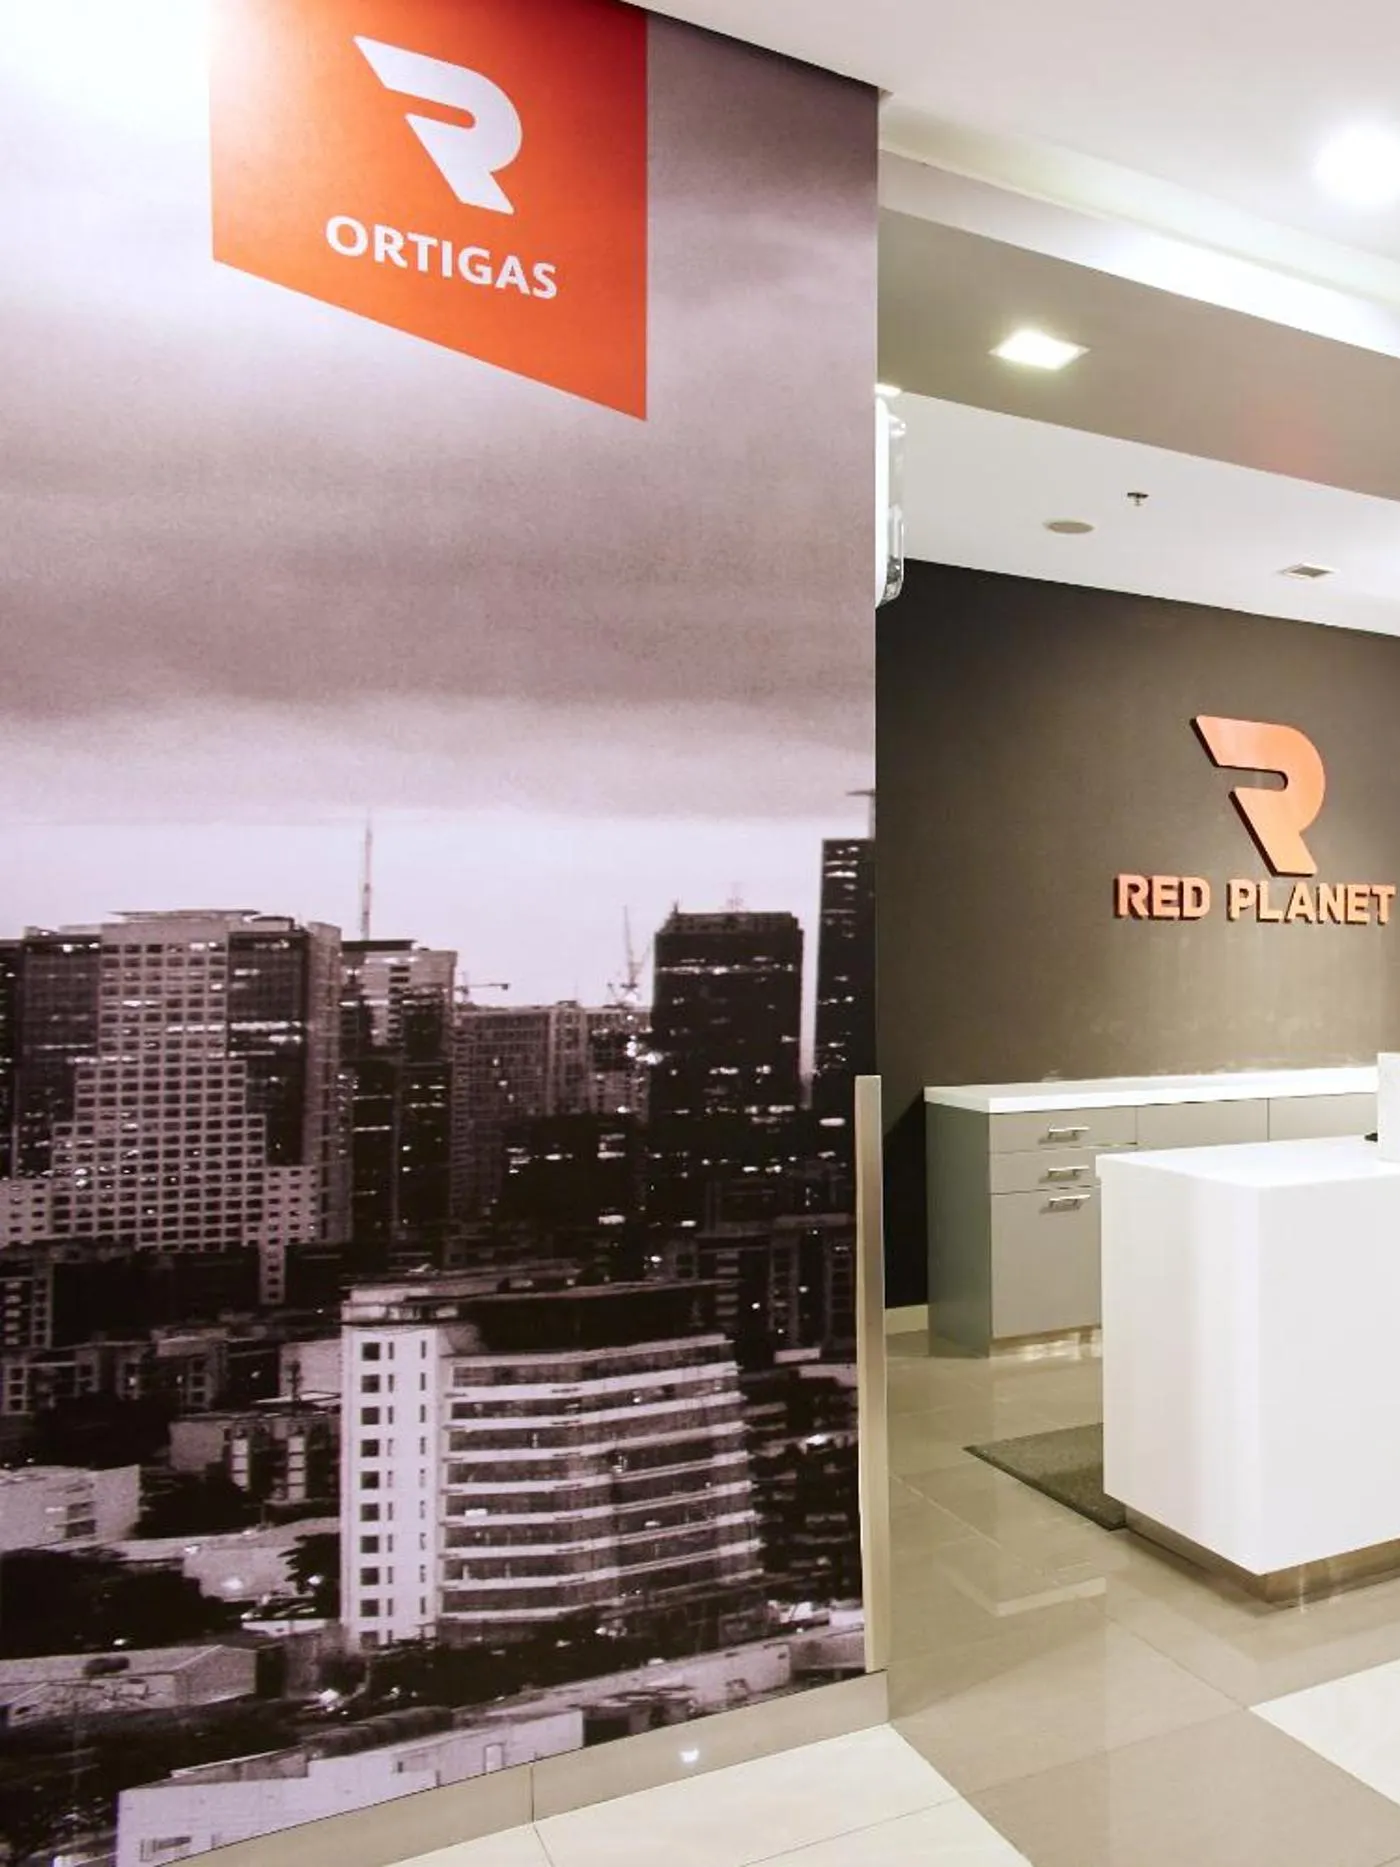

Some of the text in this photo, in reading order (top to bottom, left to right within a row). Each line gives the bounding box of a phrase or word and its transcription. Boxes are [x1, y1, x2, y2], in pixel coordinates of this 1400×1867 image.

[325, 216, 558, 300] ORTIGAS
[1113, 873, 1397, 924] RED PLANET
